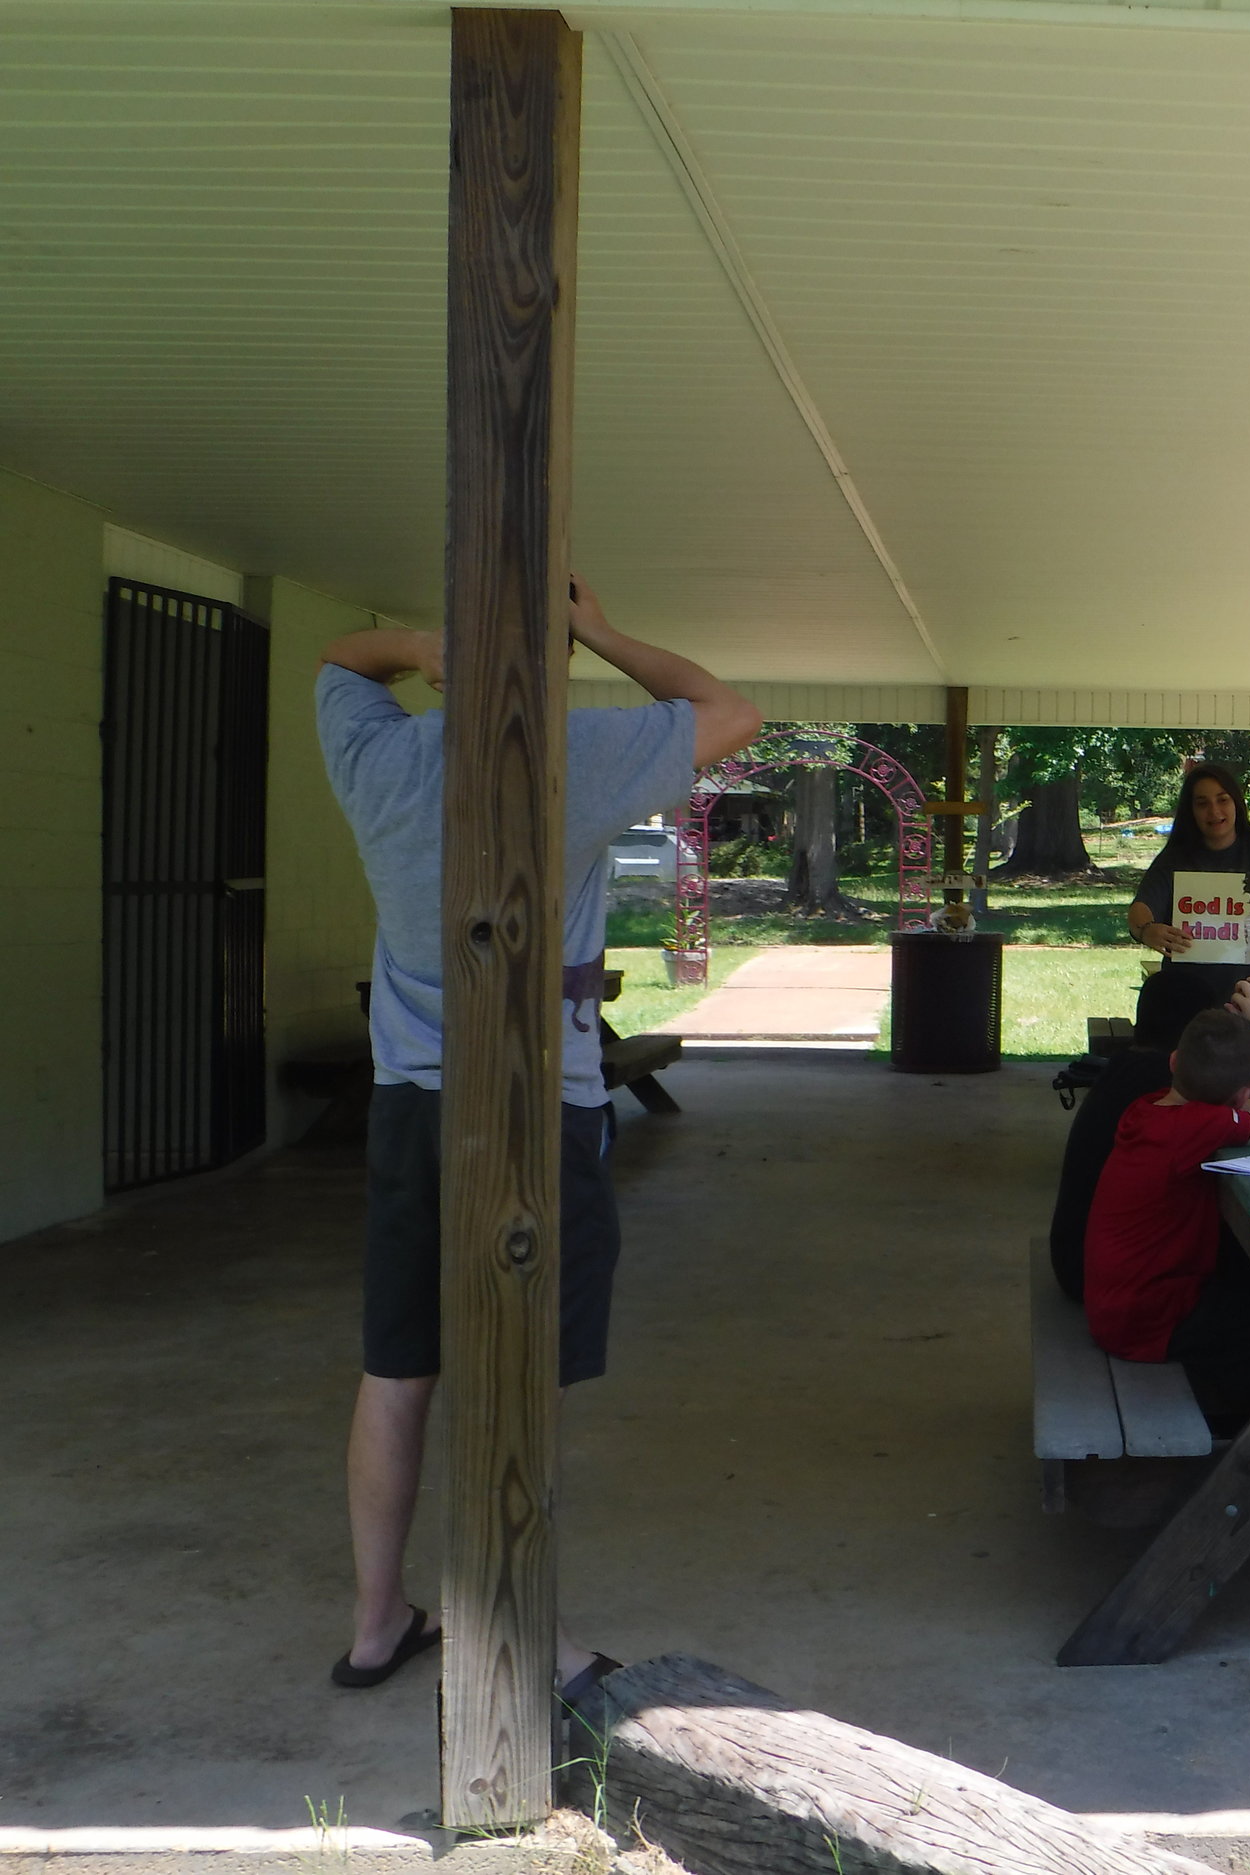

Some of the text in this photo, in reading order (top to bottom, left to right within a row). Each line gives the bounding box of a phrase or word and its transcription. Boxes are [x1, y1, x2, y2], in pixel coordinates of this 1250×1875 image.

[1178, 896, 1244, 915] God is
[1182, 921, 1239, 940] kind!
